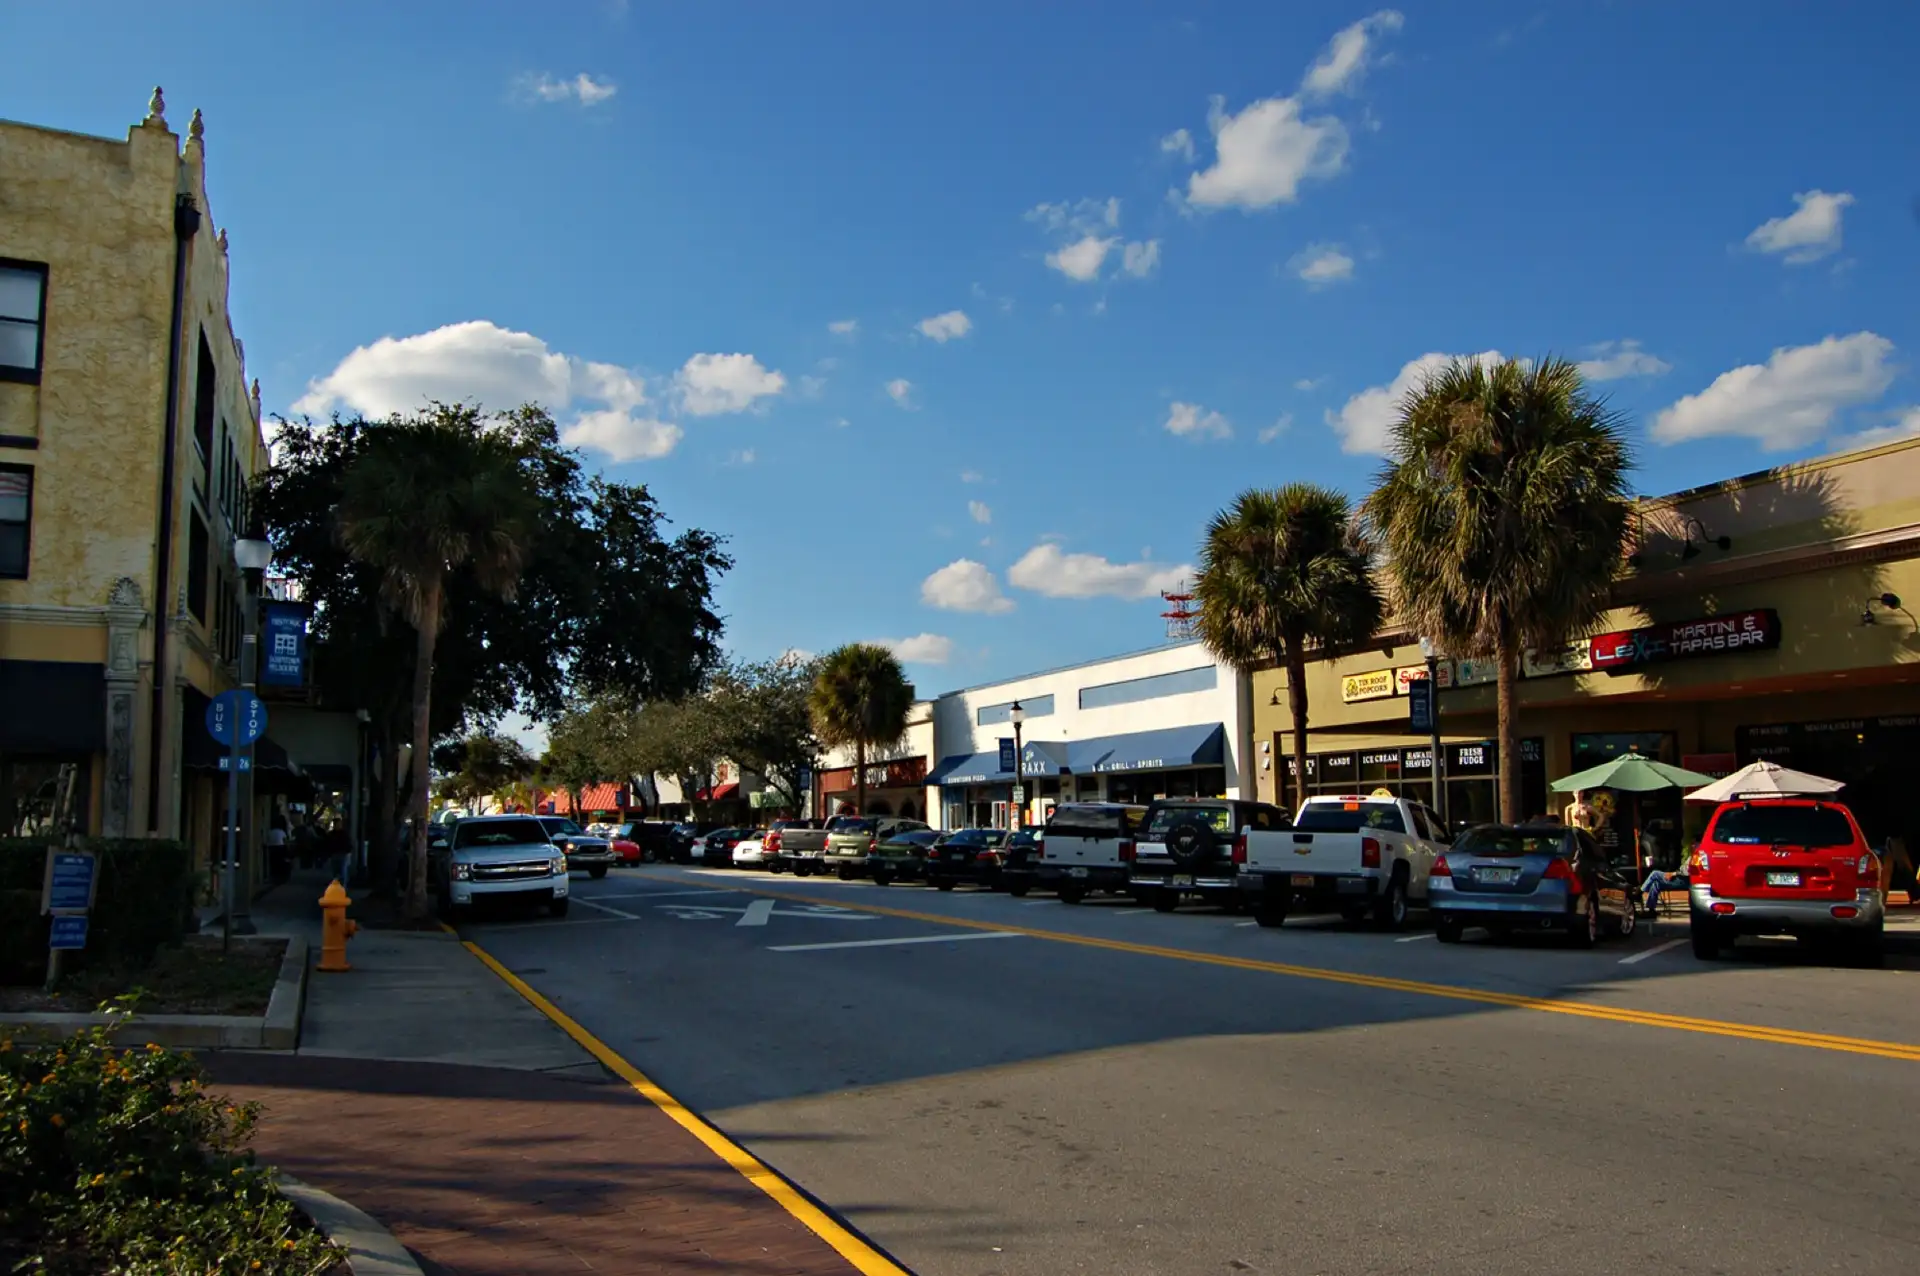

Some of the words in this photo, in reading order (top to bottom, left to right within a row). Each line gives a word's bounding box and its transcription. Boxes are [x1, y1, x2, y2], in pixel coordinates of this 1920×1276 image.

[1672, 620, 1736, 640] MARTINI
[1669, 635, 1726, 656] TAPAS
[1727, 629, 1764, 648] BAR
[1370, 675, 1387, 685] ROOF
[1359, 685, 1388, 696] POPCORN
[215, 703, 224, 732] BUS
[248, 700, 258, 738] STOP
[1459, 747, 1483, 756] FRESH
[1328, 757, 1351, 766] CANDY
[1362, 755, 1374, 764] ICE
[1374, 753, 1398, 763] CREAM
[1405, 758, 1432, 768] SHAVED
[1459, 756, 1484, 766] FUDGE
[1021, 761, 1046, 775] RAXX
[1111, 761, 1129, 771] GRILL
[1137, 758, 1163, 769] SPIRITS
